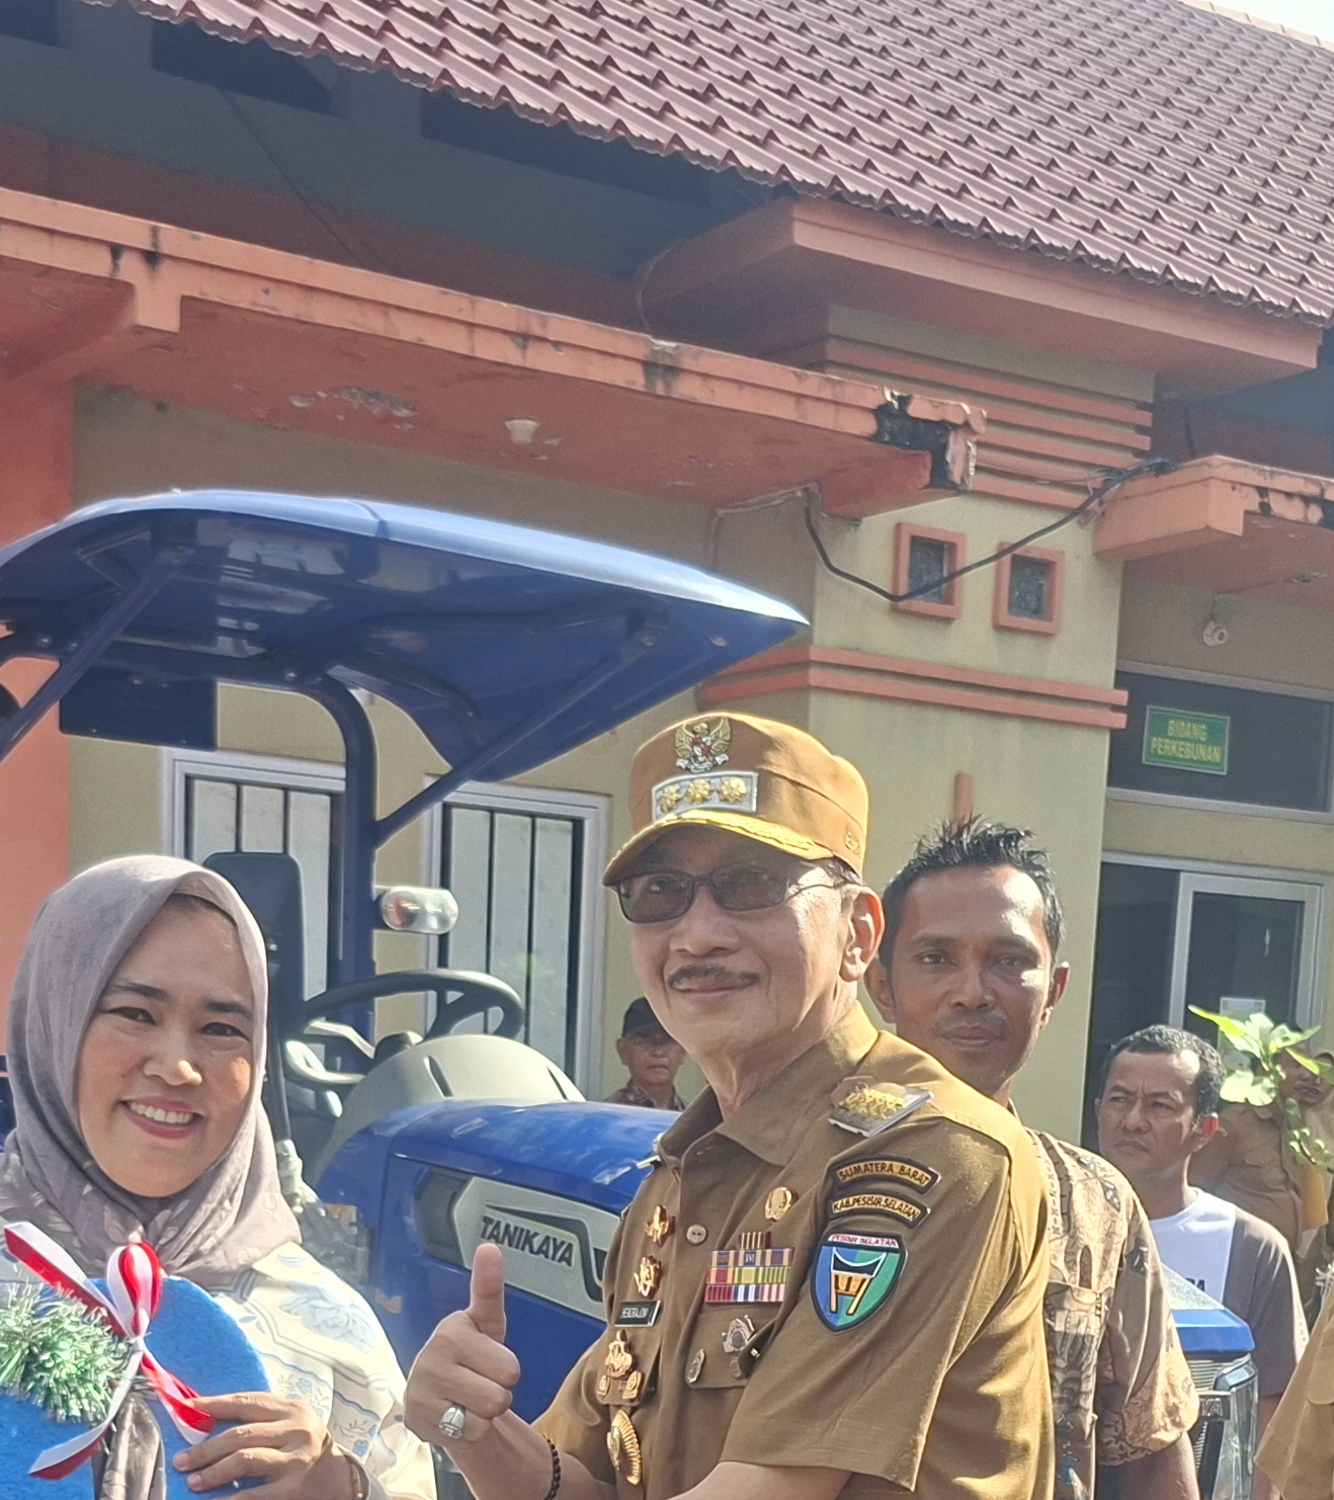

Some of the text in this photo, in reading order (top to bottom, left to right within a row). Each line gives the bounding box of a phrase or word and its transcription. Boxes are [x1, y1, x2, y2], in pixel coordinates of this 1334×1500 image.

[1168, 719, 1207, 741] BIDANG
[1150, 737, 1221, 763] PERKEBUNAN
[838, 1162, 930, 1186] SUMATERA BARAT
[480, 1215, 574, 1267] TANIKAYA
[859, 1236, 897, 1247] SELATAN
